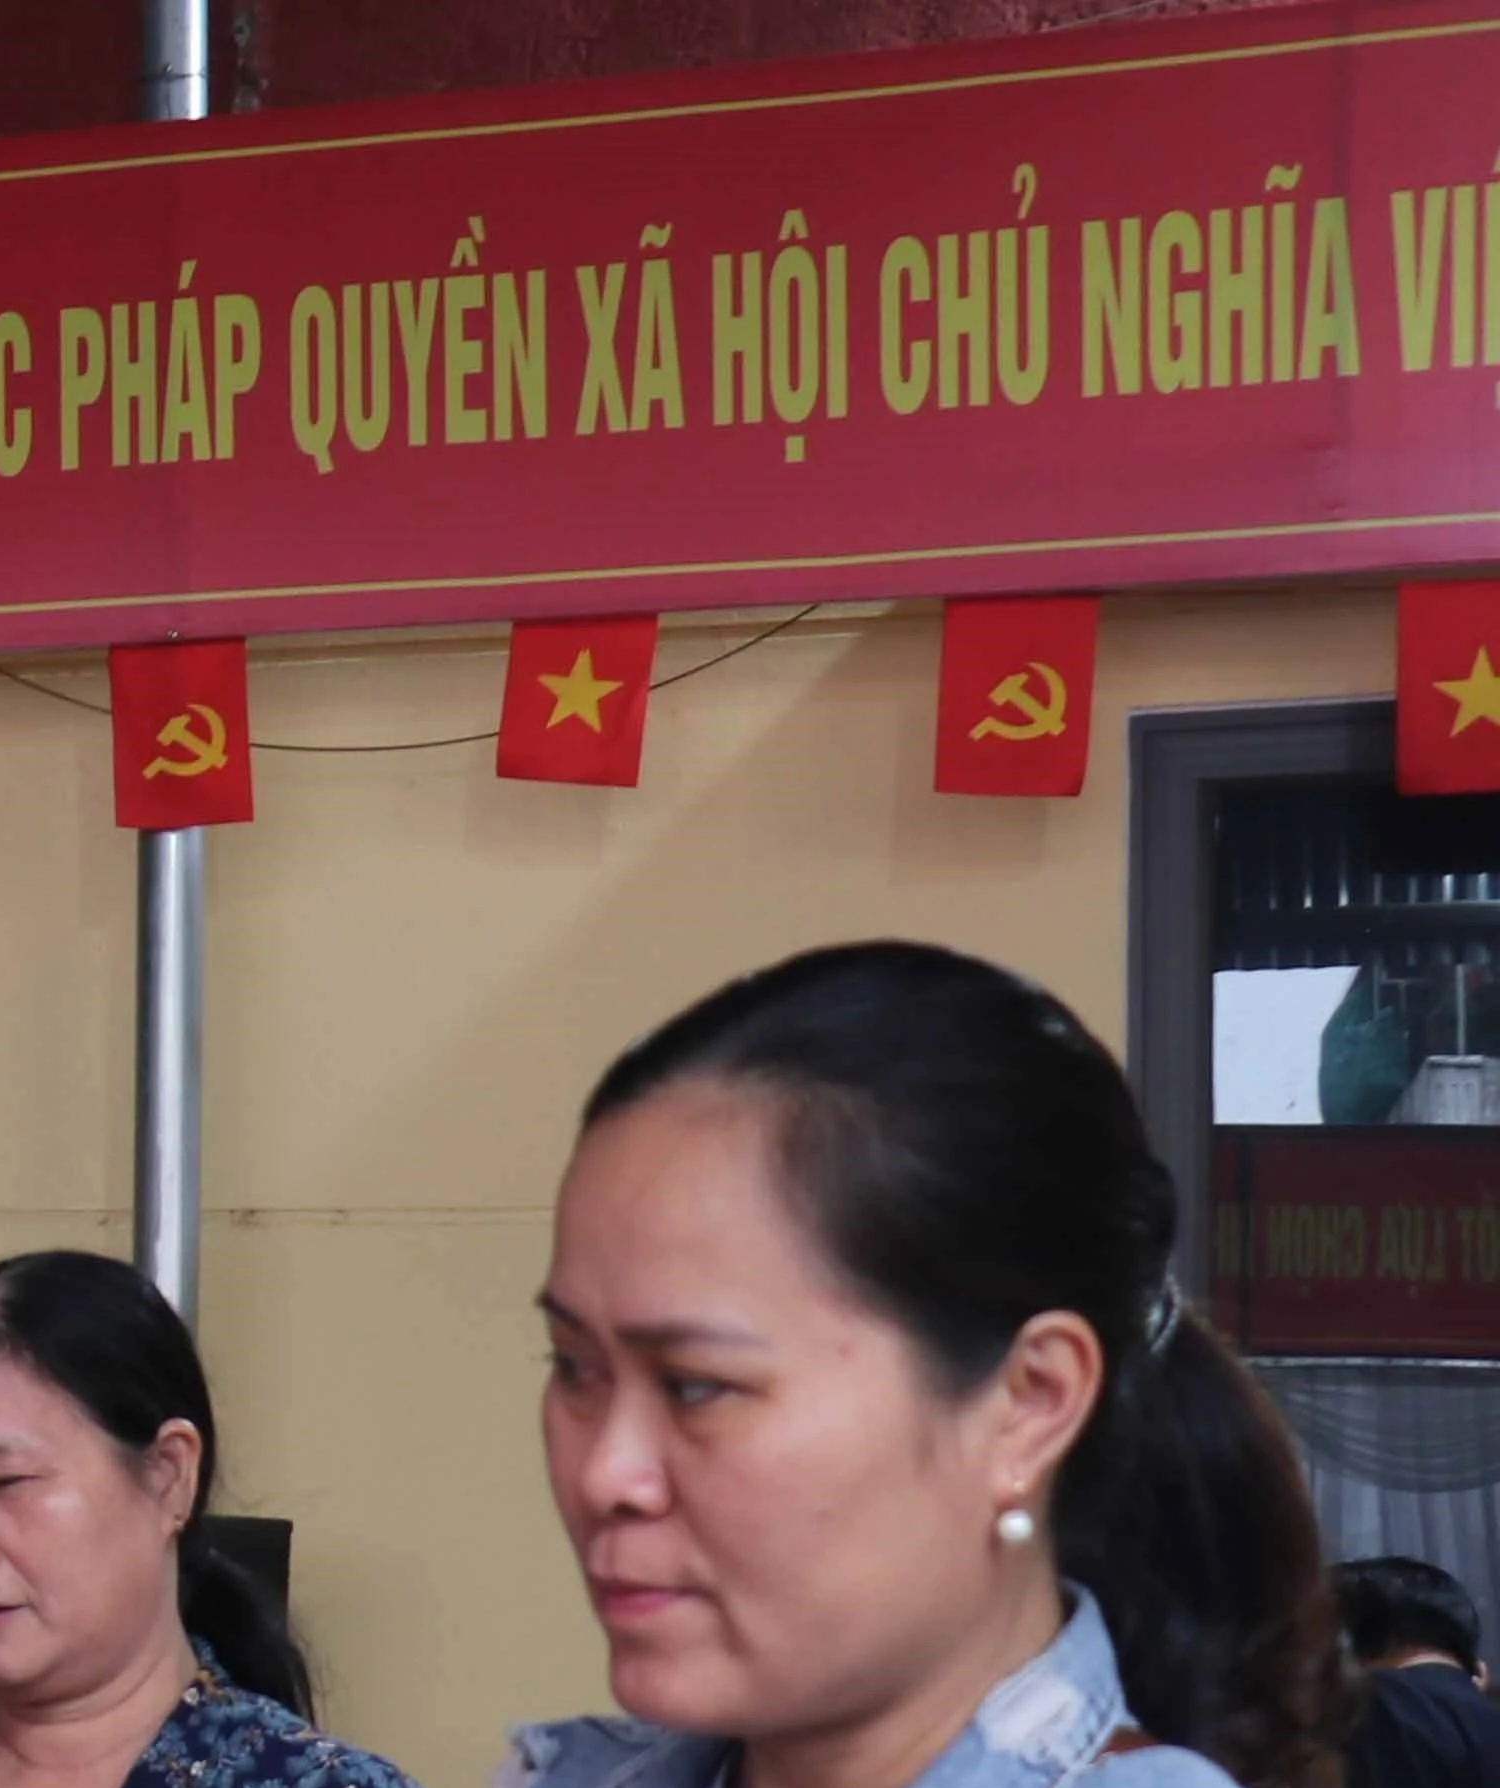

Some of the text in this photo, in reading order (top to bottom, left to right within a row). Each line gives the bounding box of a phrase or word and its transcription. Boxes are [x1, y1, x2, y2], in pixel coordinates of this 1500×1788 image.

[61, 260, 262, 470] PHÁP
[290, 216, 548, 473] QUYỀN
[577, 225, 685, 435] XÃ
[713, 209, 849, 462] HỘI
[880, 163, 1050, 413] CHỦ
[1082, 165, 1361, 397] NGHĨA
